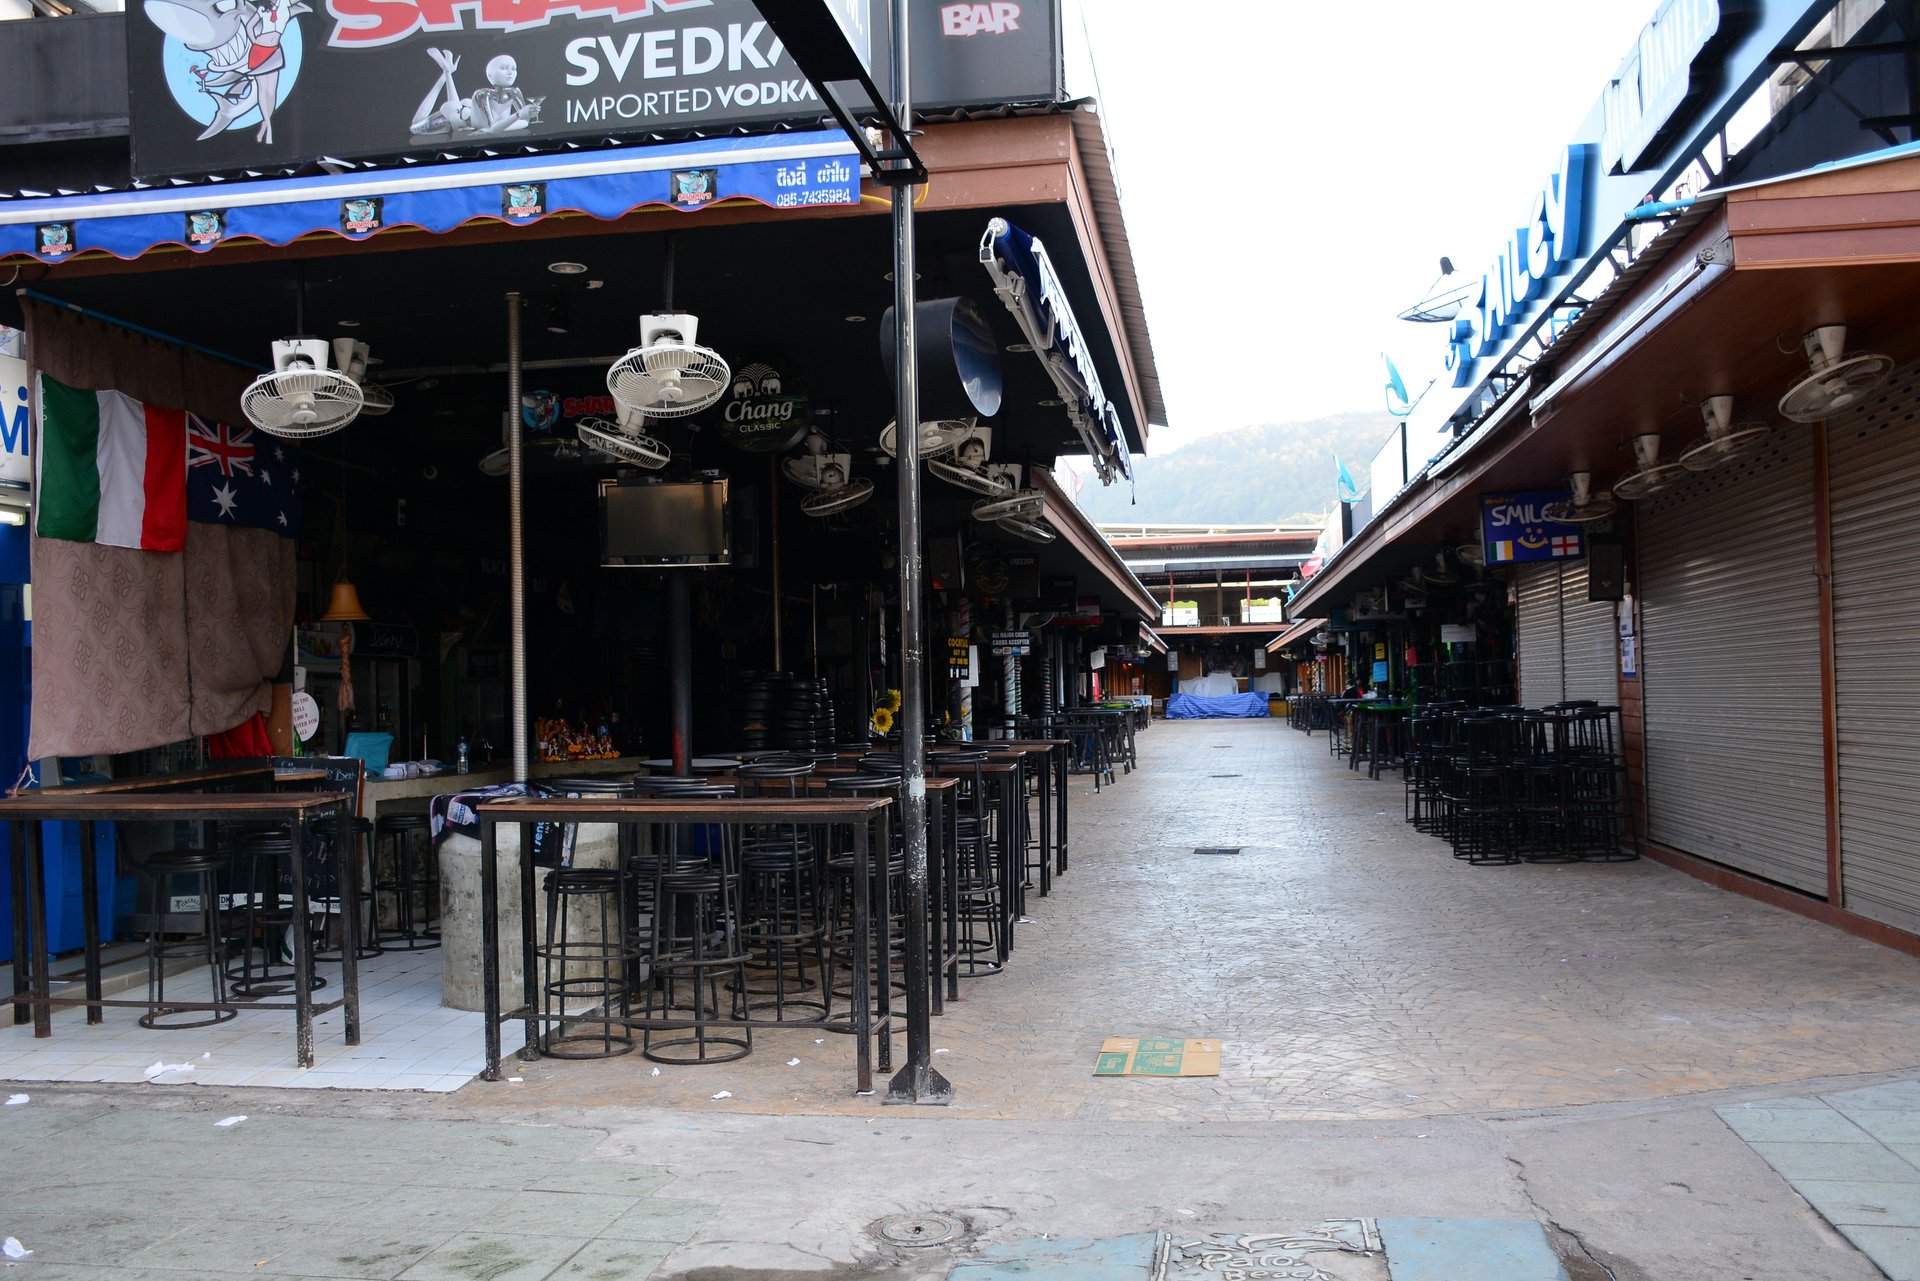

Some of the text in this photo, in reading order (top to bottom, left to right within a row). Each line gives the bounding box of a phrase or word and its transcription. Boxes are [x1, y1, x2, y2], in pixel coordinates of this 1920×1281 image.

[941, 2, 1020, 36] BAR
[566, 79, 818, 124] IMPORTED VODKA
[776, 188, 851, 206] 085-7435984
[724, 400, 794, 423] Chang
[739, 422, 782, 433] CLASSIC
